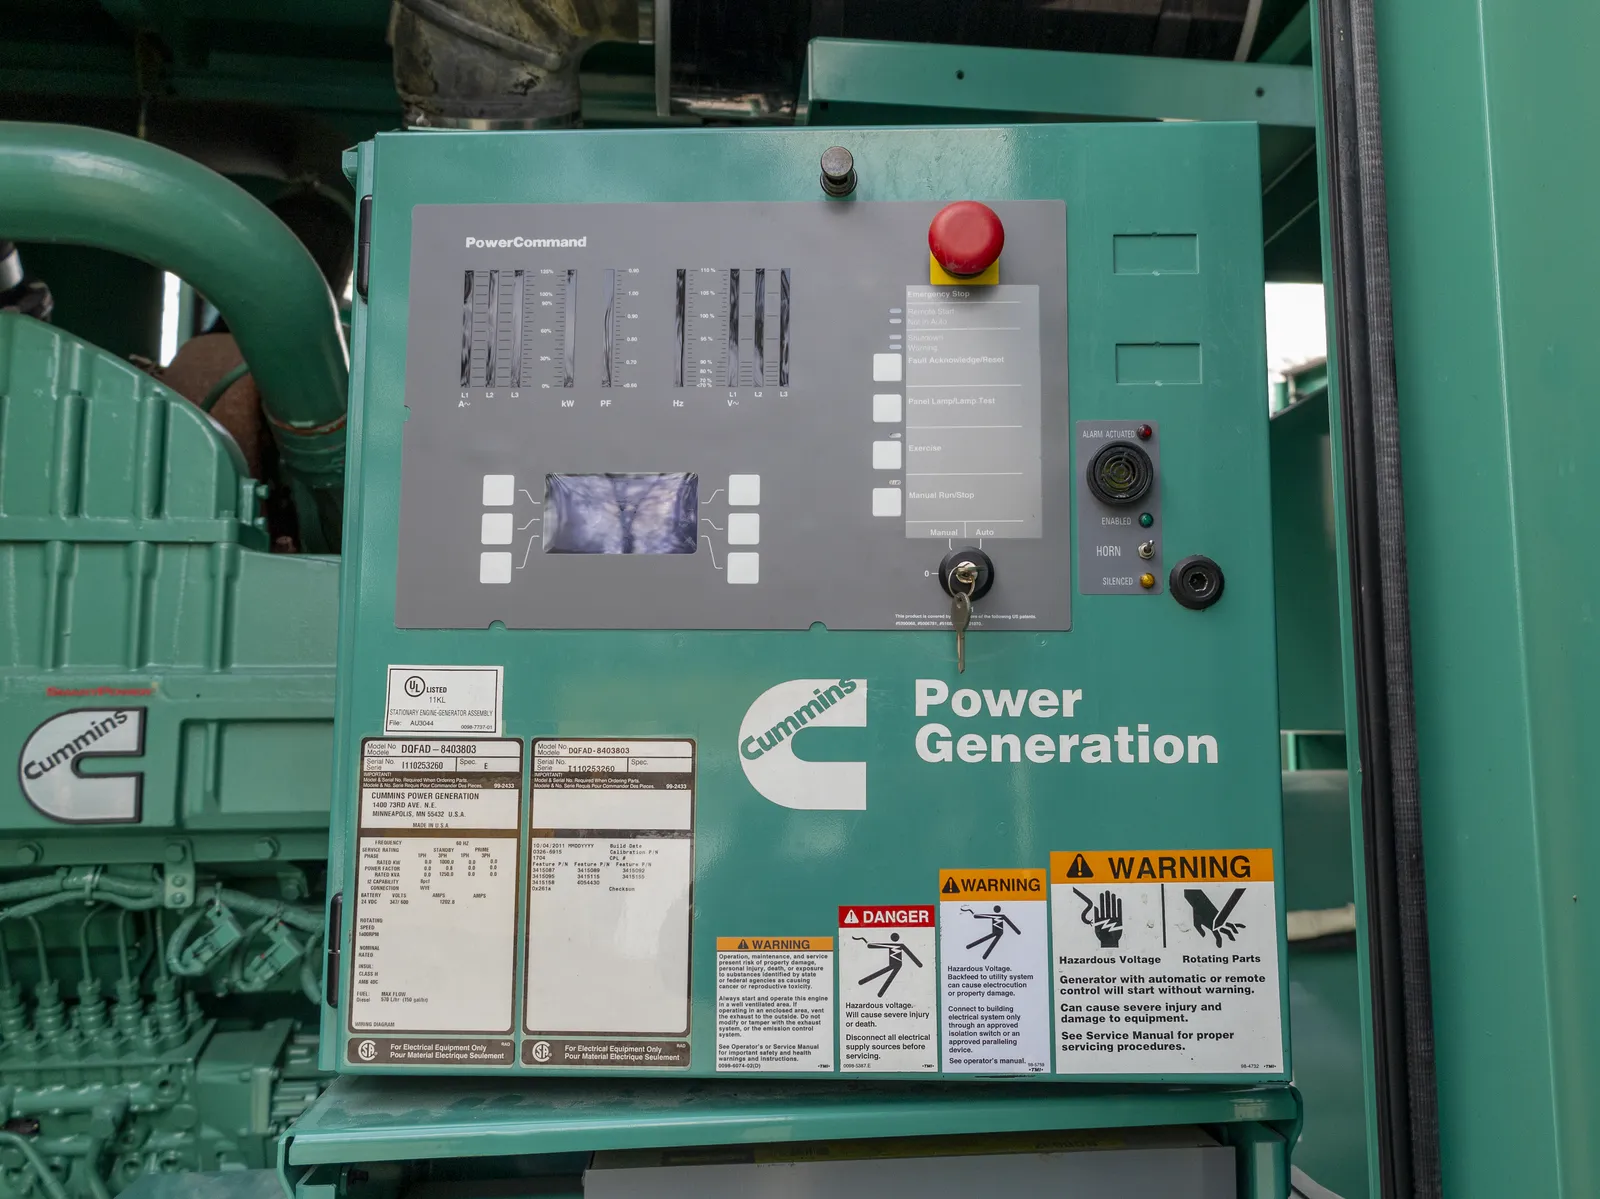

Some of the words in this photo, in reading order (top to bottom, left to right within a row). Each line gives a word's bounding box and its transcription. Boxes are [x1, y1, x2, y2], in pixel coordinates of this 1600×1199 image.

[465, 236, 587, 248] PowerCommand
[907, 290, 950, 299] Emergency
[952, 290, 970, 298] Stop
[929, 356, 1004, 365] Acknowledge/Reset
[931, 397, 976, 406] Lamp/Lamp
[1083, 430, 1103, 438] ALARM
[1105, 430, 1136, 438] ACTUATED
[938, 491, 974, 500] Run/Stop
[1101, 517, 1132, 525] ENABLED
[1096, 545, 1121, 557] HORN
[1102, 577, 1134, 585] SILENCED
[915, 679, 1082, 717] Power
[740, 678, 858, 761] Cummins
[23, 710, 128, 780] Cummins
[915, 723, 1218, 764] Generation
[1107, 855, 1251, 879] WARNING
[961, 878, 1041, 892] WARNING
[863, 910, 929, 923] DANGER
[752, 940, 810, 950] WARNING
[1059, 956, 1116, 964] Hazardous
[1119, 955, 1162, 966] Voltage
[1182, 955, 1229, 965] Rotating
[1232, 955, 1261, 963] Parts
[1060, 975, 1117, 984] Generator
[1120, 975, 1145, 984] with
[1148, 974, 1207, 984] automatic
[1210, 975, 1222, 983] or
[1225, 974, 1266, 983] remote
[1060, 986, 1100, 995] control
[1103, 986, 1124, 995] will
[1127, 986, 1155, 995] start
[1158, 985, 1202, 995] without
[1205, 985, 1255, 996] warning.
[885, 1002, 914, 1010] voltage.
[1060, 1003, 1082, 1013] Can
[1085, 1004, 1120, 1013] cause
[1123, 1004, 1162, 1012] severe
[1165, 1003, 1197, 1013] injury
[1200, 1002, 1222, 1011] and
[909, 1011, 930, 1019] injury
[1061, 1014, 1106, 1025] damage
[1109, 1015, 1121, 1023] to
[1124, 1014, 1188, 1024] equipment.
[1061, 1032, 1082, 1040] See
[1086, 1031, 1129, 1040] Service
[1132, 1031, 1174, 1040] Manual
[1177, 1031, 1193, 1040] for
[1196, 1031, 1235, 1042] proper
[434, 1044, 470, 1053] Equipment
[845, 1043, 870, 1052] supply
[1061, 1042, 1114, 1053] servicing
[1117, 1042, 1186, 1052] procedures.
[435, 1052, 468, 1060] Electrique
[845, 1052, 881, 1061] servicing.
